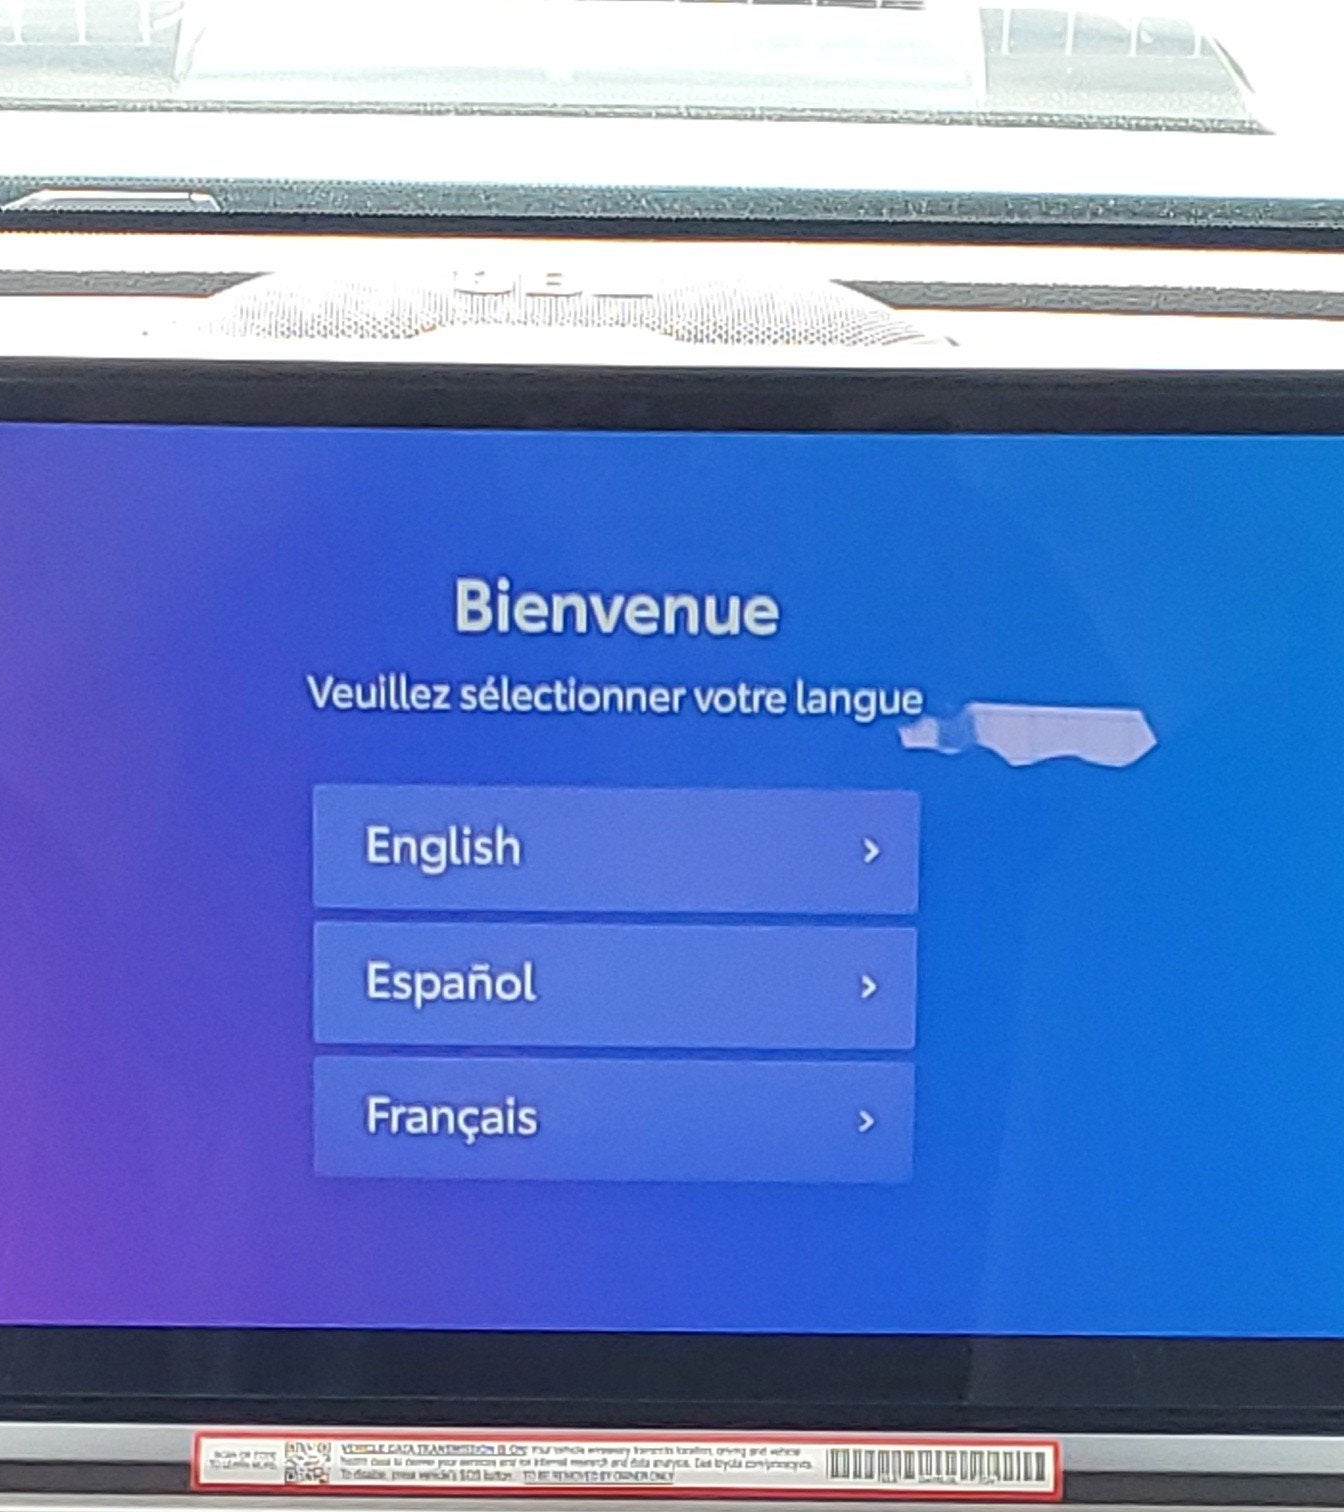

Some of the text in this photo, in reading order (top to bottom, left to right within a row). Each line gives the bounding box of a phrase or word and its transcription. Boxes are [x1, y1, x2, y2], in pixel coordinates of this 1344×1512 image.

[454, 577, 781, 636] Bienvenue
[307, 672, 924, 723] Veuillez sélectionner votre langue
[365, 824, 522, 875] English
[365, 960, 538, 1010] Español
[365, 1095, 540, 1146] Français
